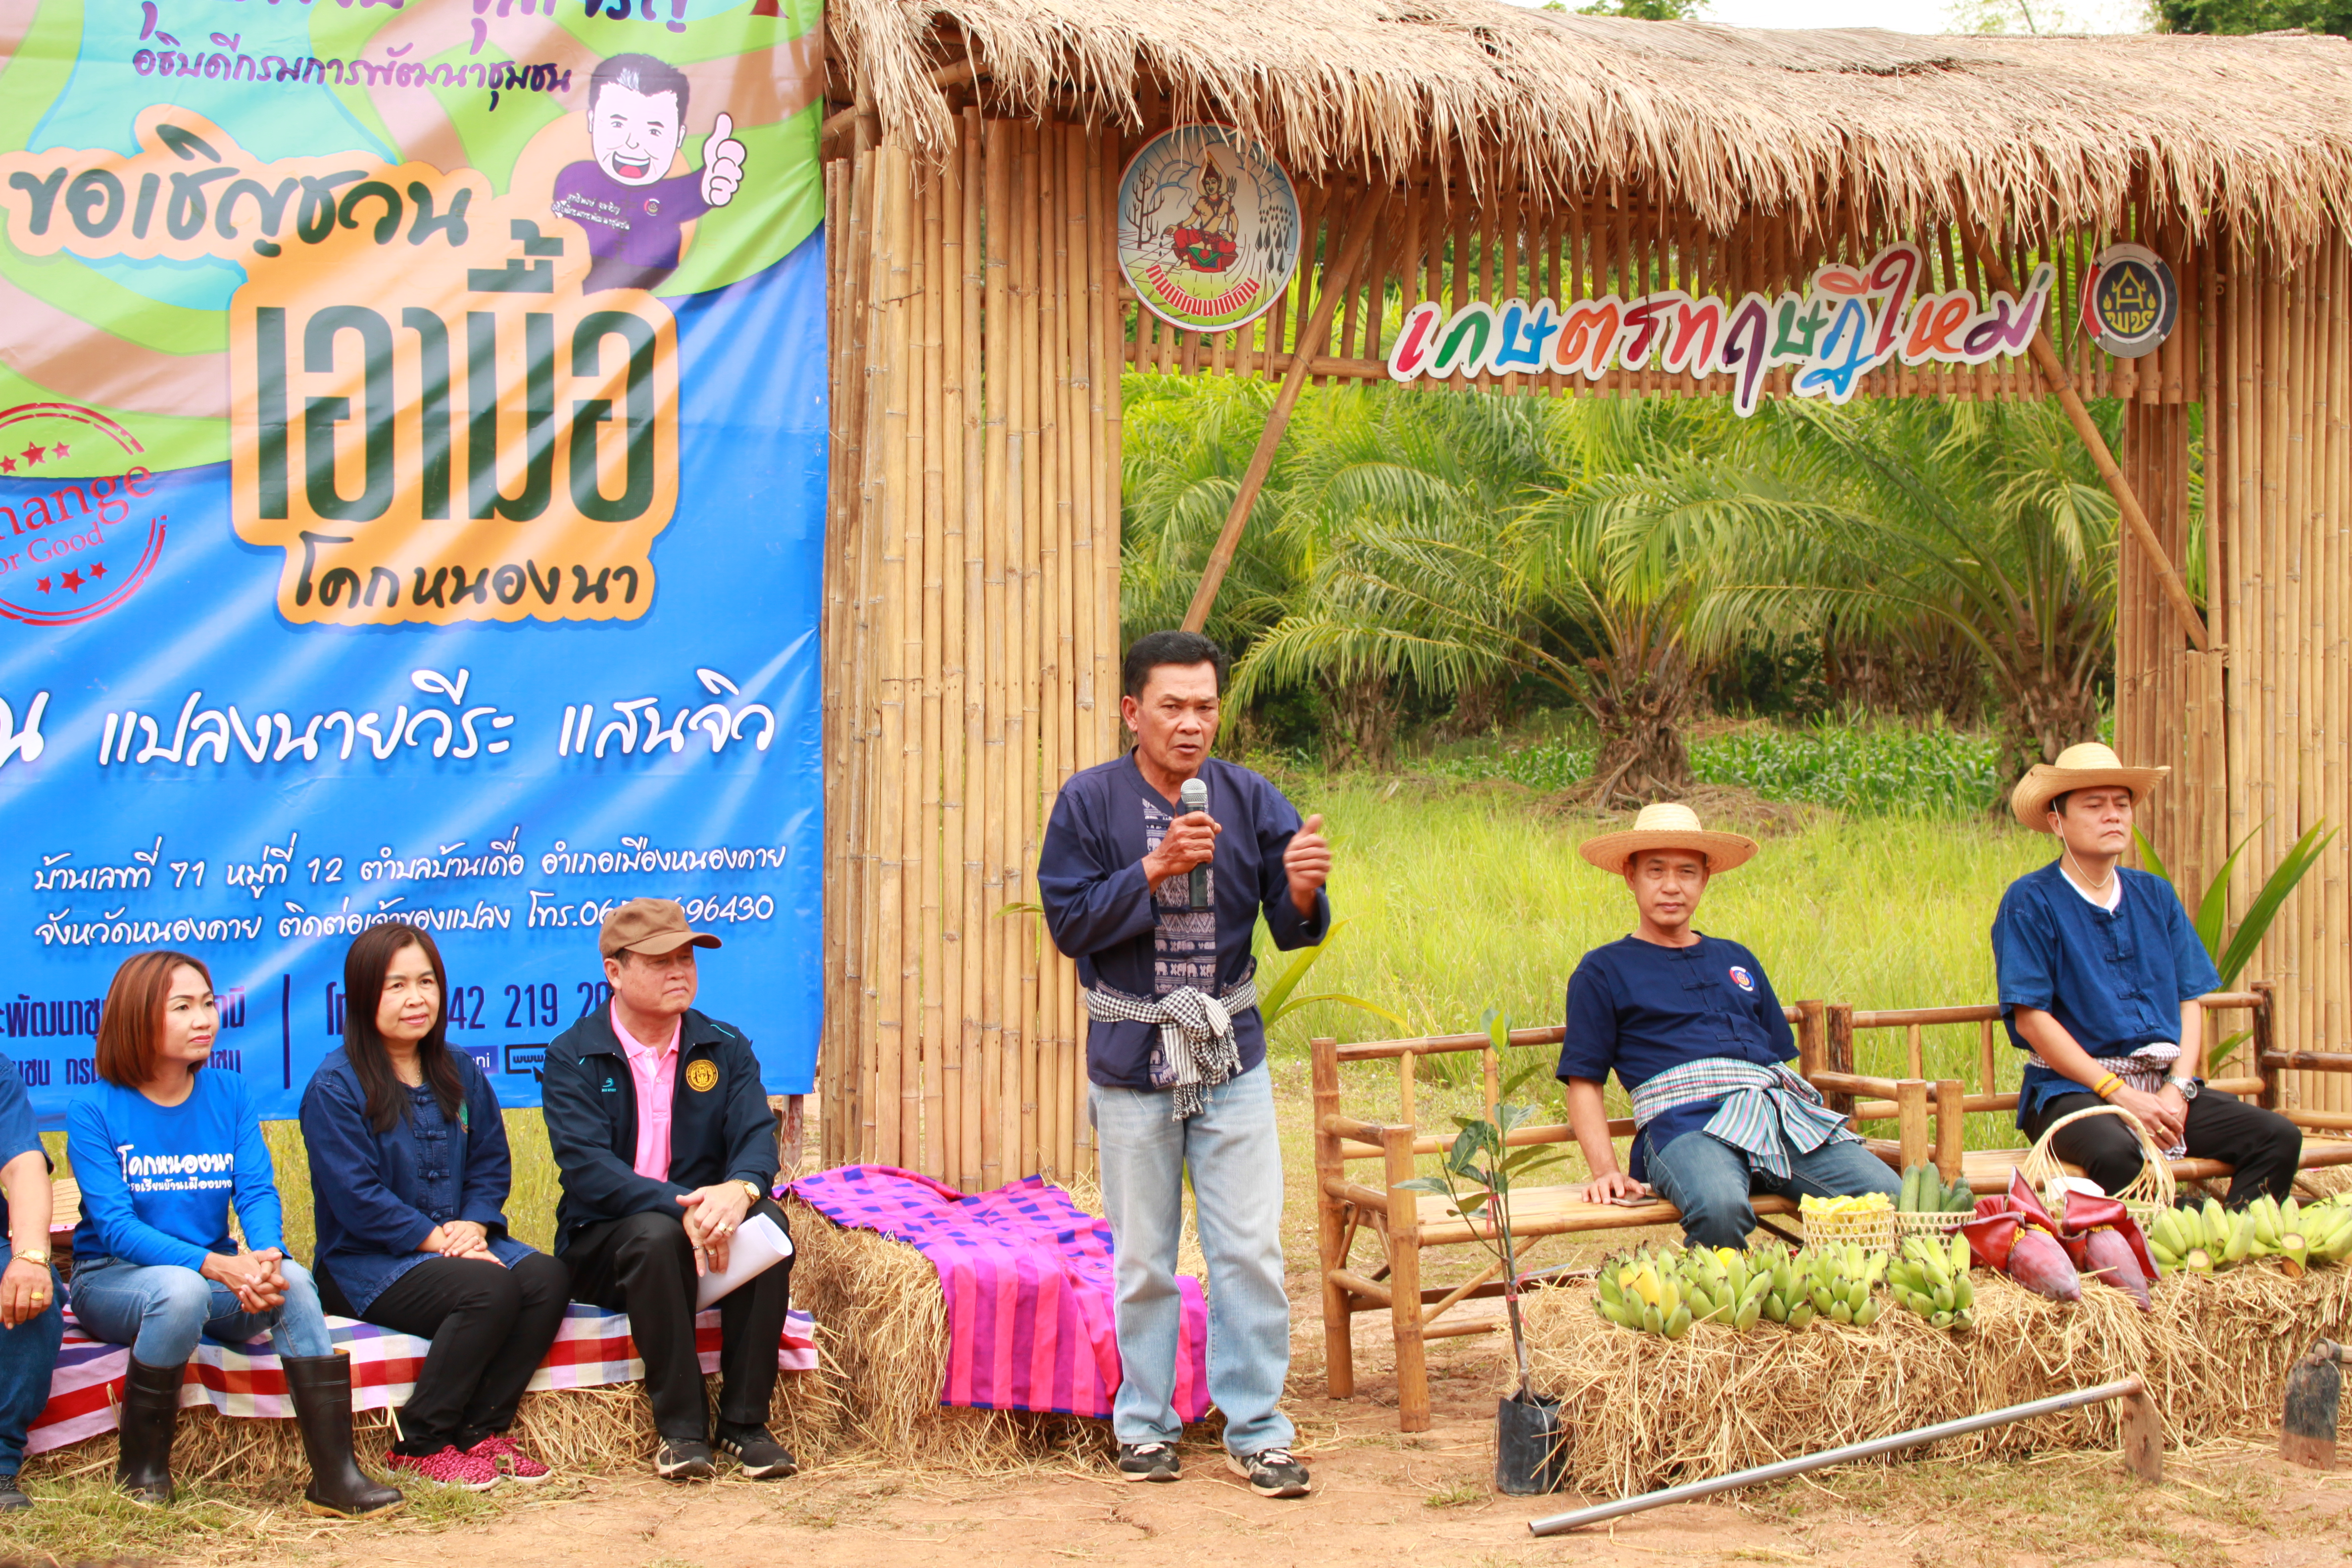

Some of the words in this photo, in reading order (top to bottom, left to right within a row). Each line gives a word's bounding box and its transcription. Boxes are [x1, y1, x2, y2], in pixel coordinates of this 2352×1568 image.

[133, 31, 572, 112] อธิบดีกรมการพัฒนาชุมชน
[8, 124, 472, 258] ขอเชิญชวน
[1145, 264, 1261, 317] กรมพัฒนาที่ดิน
[1395, 248, 2050, 409] เกษตรทฤษฎีใหม่
[256, 218, 657, 523] เอามื้อ
[27, 522, 105, 563] Good
[295, 530, 638, 608] โคกหนองนา
[99, 669, 514, 767] แปลงนายวีระ
[35, 835, 162, 890] บ้านเลขที่
[170, 861, 204, 887] 71
[227, 832, 297, 899] หมู่ที่
[308, 857, 342, 882] 12
[360, 826, 525, 880] ตำบลบ้านเดื่อ
[542, 836, 786, 874] อำเภอเมืองหนองคาย
[36, 907, 262, 945] จังหวัดหนองคาย
[504, 983, 558, 1028] 219
[117, 1144, 234, 1183] โคกหนองนา
